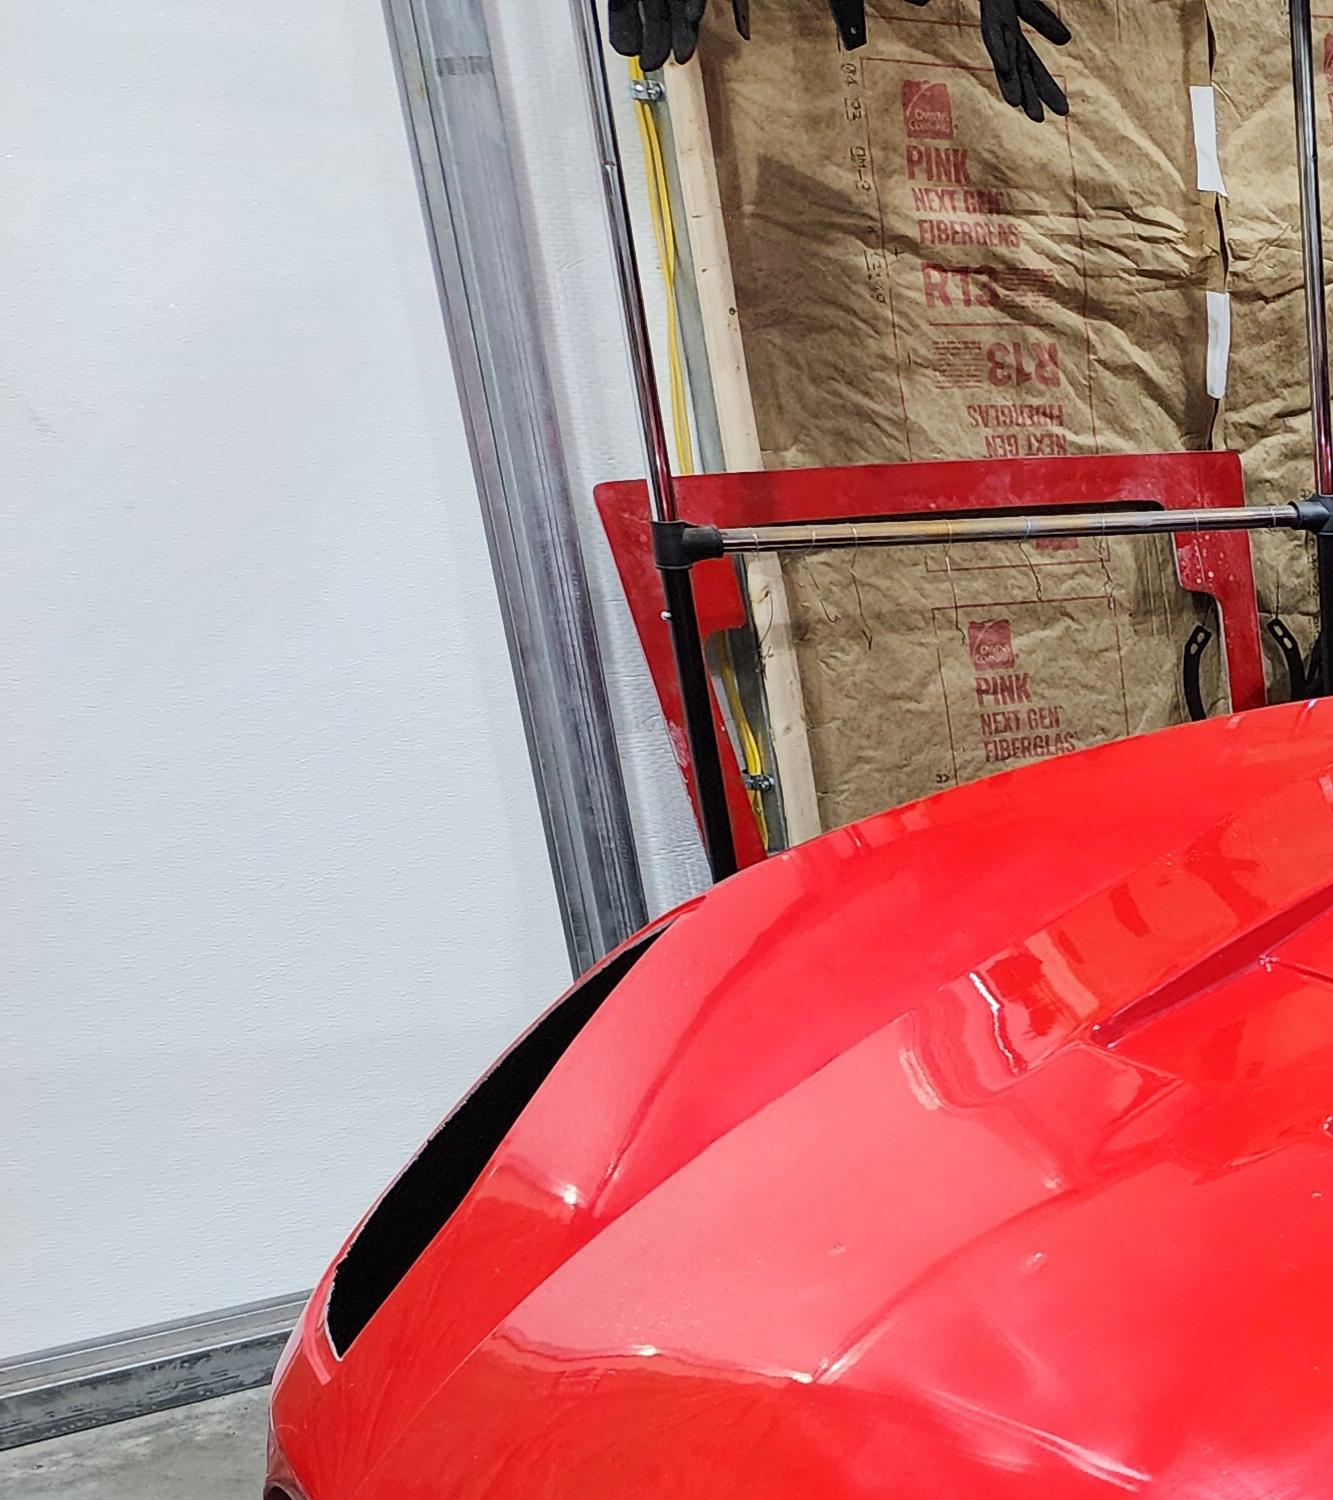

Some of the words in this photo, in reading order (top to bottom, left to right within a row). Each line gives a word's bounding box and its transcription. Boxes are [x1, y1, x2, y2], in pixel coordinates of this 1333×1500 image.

[906, 145, 971, 185] PINK
[911, 187, 957, 213] NEXT
[917, 219, 1021, 249] FIBERGLAS
[920, 261, 1001, 309] R13
[985, 341, 1062, 388] R13
[966, 403, 1065, 428] FIBERGLAS
[983, 434, 1020, 458] GEN
[1026, 433, 1069, 457] NEXT
[974, 672, 1033, 707] PINK
[979, 709, 1022, 736] NEXT
[1026, 704, 1062, 730] GEN
[982, 731, 1079, 763] FIBERGLAS
